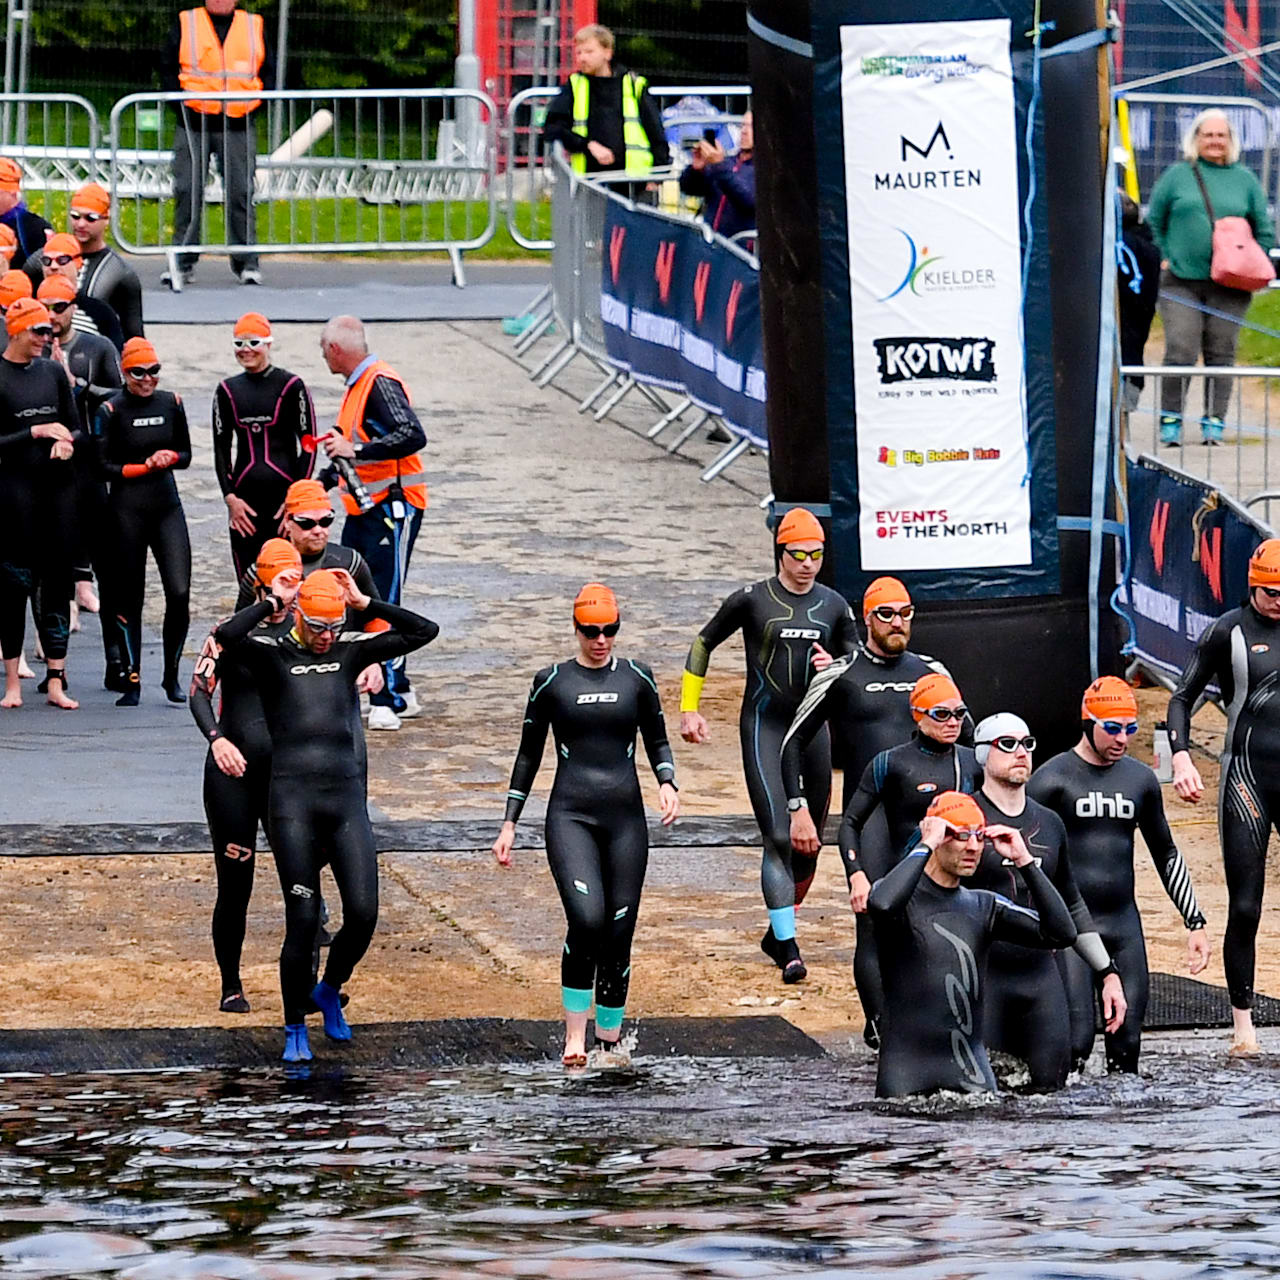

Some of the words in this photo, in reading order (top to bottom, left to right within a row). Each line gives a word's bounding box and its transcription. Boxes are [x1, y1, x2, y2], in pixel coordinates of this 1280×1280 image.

[861, 54, 967, 67] NORTHUMBRIAN
[875, 169, 981, 190] MAURTEN
[924, 269, 995, 285] KIELDER
[885, 341, 988, 378] KOTWF
[903, 449, 924, 466] Big
[927, 448, 970, 462] Bobble
[973, 447, 1001, 461] Hats
[876, 510, 948, 523] EVENTS
[876, 526, 899, 539] OF
[903, 525, 938, 539] THE
[943, 522, 1007, 536] NORTH
[290, 662, 341, 675] orca
[1076, 792, 1135, 819] dhb
[224, 842, 252, 862] S7
